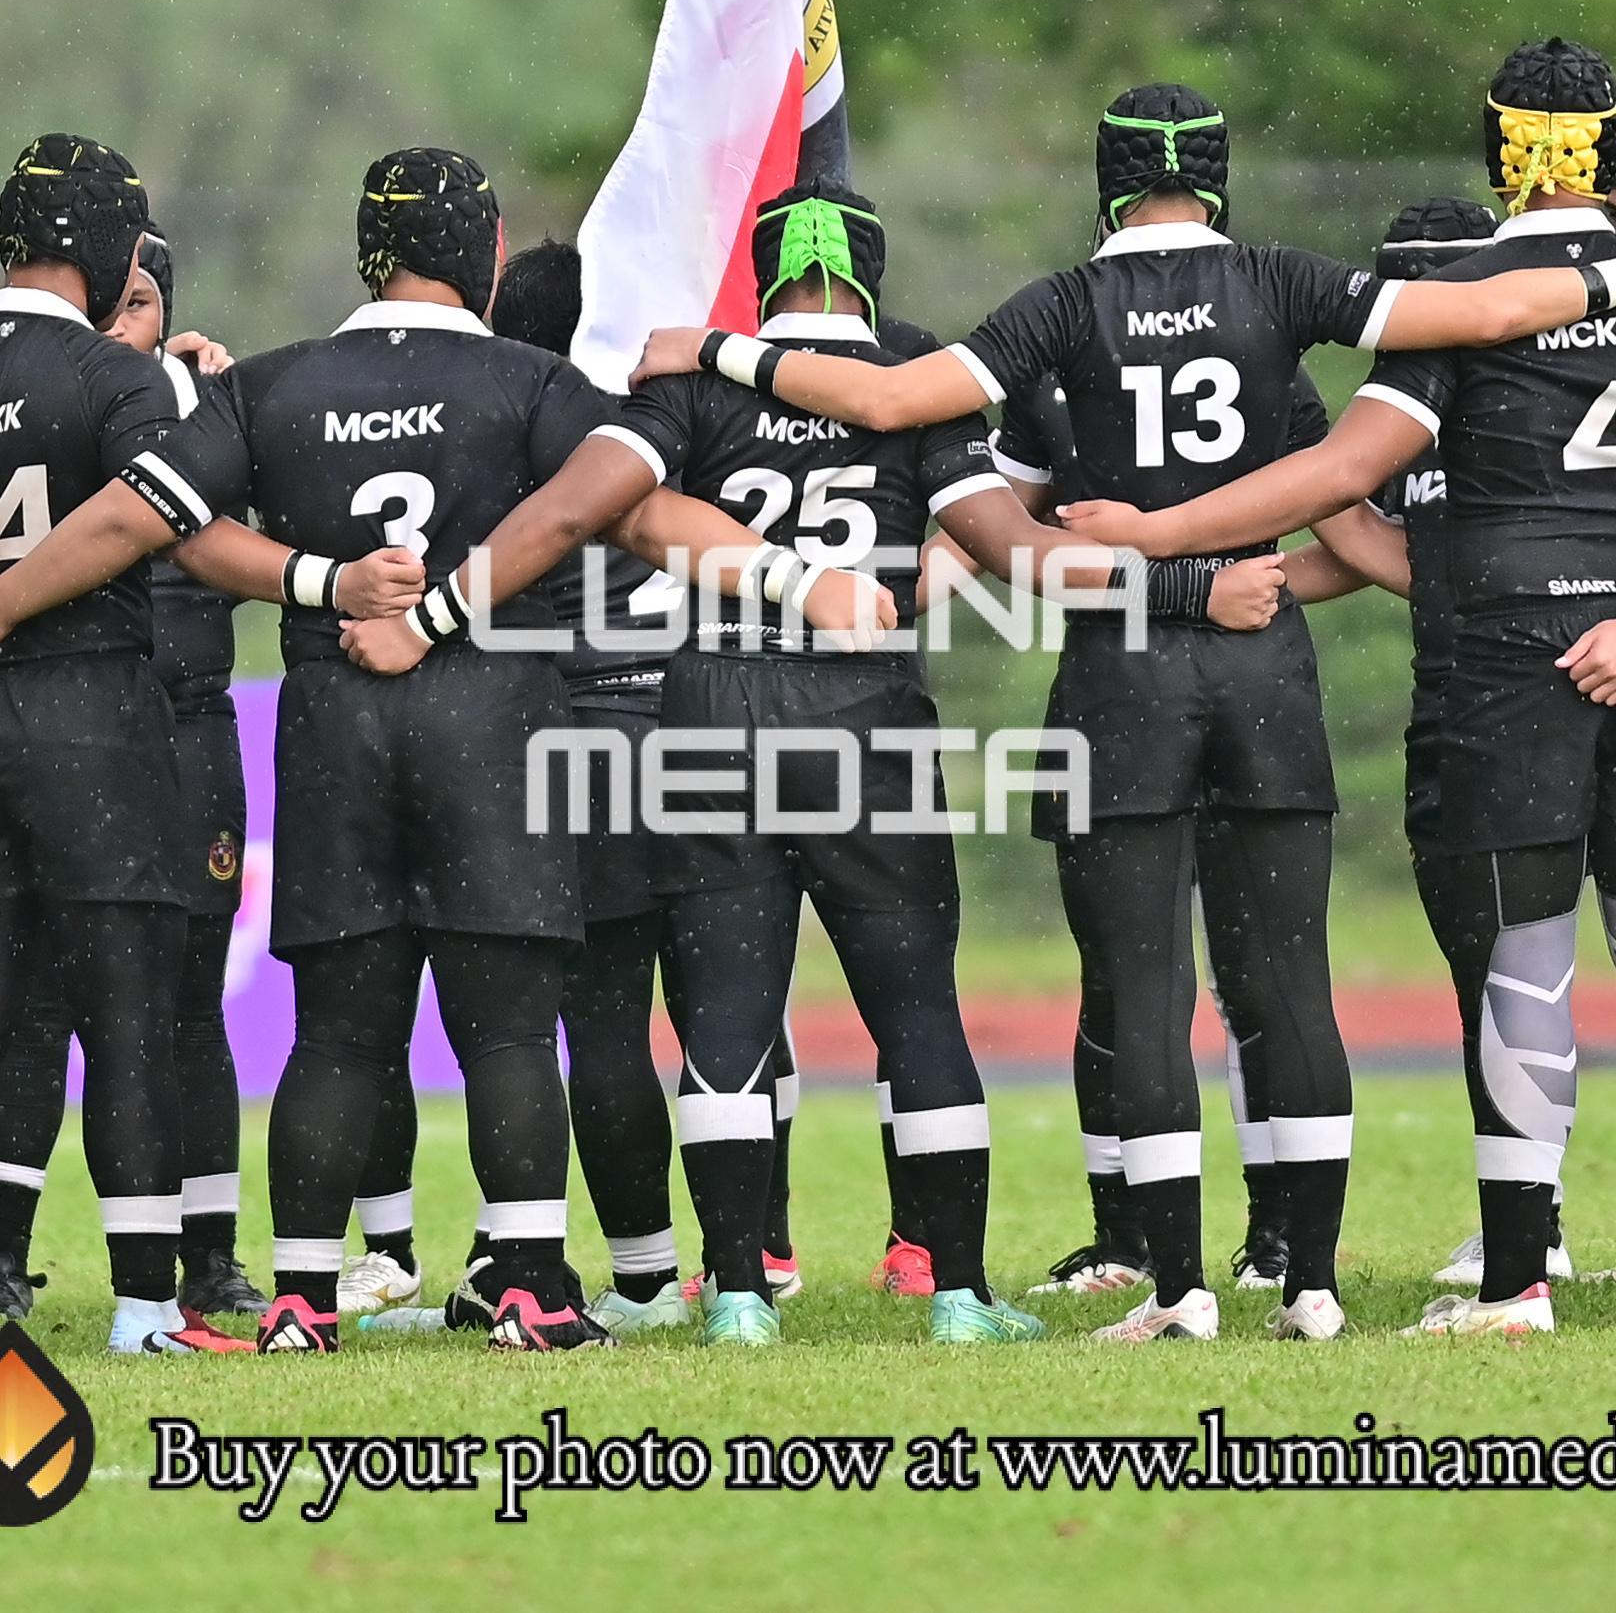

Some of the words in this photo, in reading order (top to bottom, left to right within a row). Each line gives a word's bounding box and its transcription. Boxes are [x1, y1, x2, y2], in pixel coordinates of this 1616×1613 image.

[1126, 303, 1217, 337] MCKK
[324, 403, 445, 442] MCKK
[755, 411, 851, 445] MCKK
[1121, 357, 1246, 467] 13
[350, 471, 435, 567] 3
[719, 465, 878, 567] 25
[1548, 580, 1616, 595] SMART
[697, 622, 756, 634] SMART
